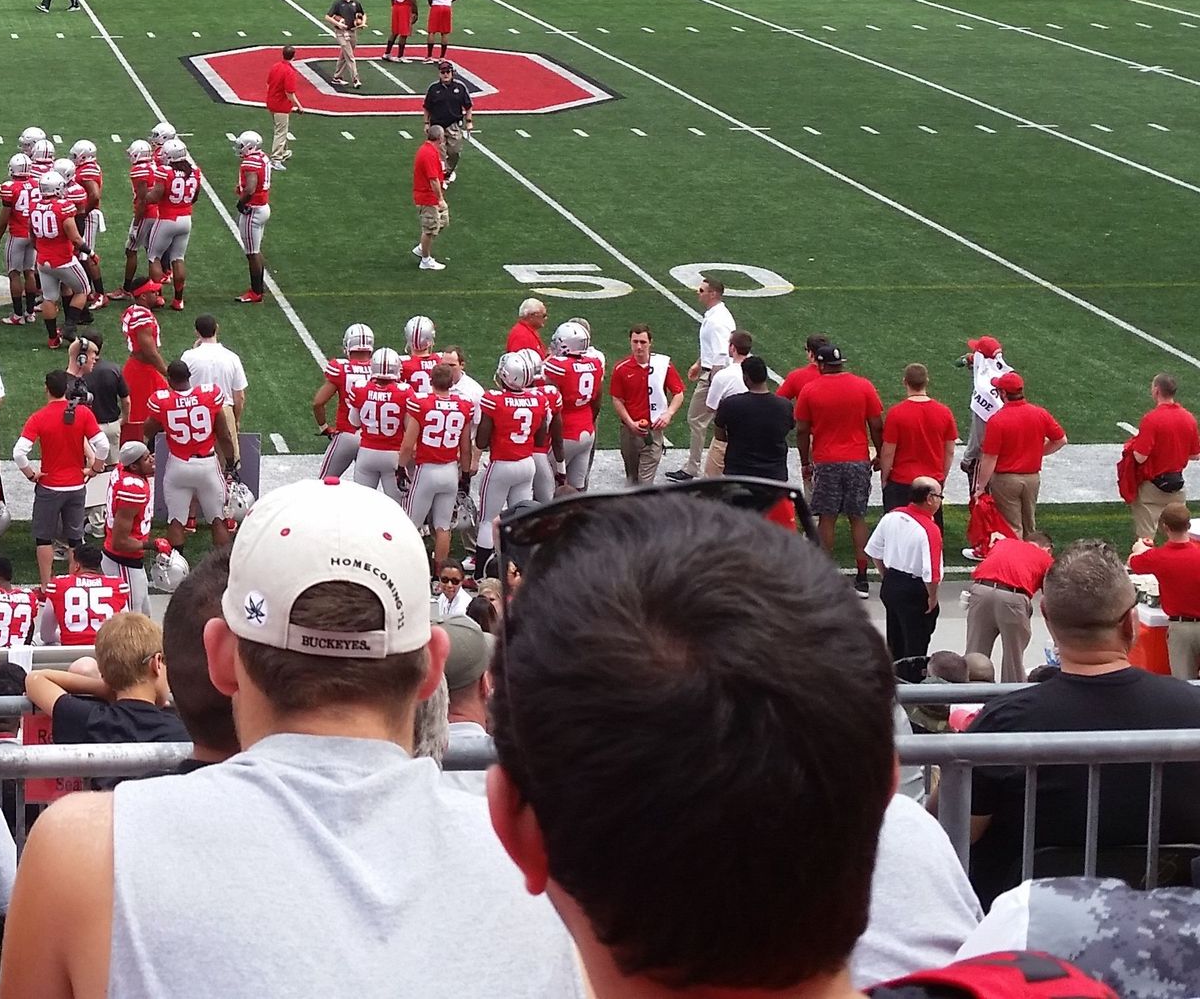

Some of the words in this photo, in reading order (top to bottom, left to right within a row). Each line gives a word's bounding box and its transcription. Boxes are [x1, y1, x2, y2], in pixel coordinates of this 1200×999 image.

[168, 177, 198, 204] 93
[30, 209, 58, 239] 90
[175, 395, 199, 408] LEWIS
[575, 373, 595, 407] 9
[166, 405, 212, 445] 59
[359, 400, 400, 437] 46
[422, 409, 466, 448] 28
[509, 408, 533, 444] 3
[330, 557, 403, 610] HOMECOMING
[63, 586, 114, 633] 85
